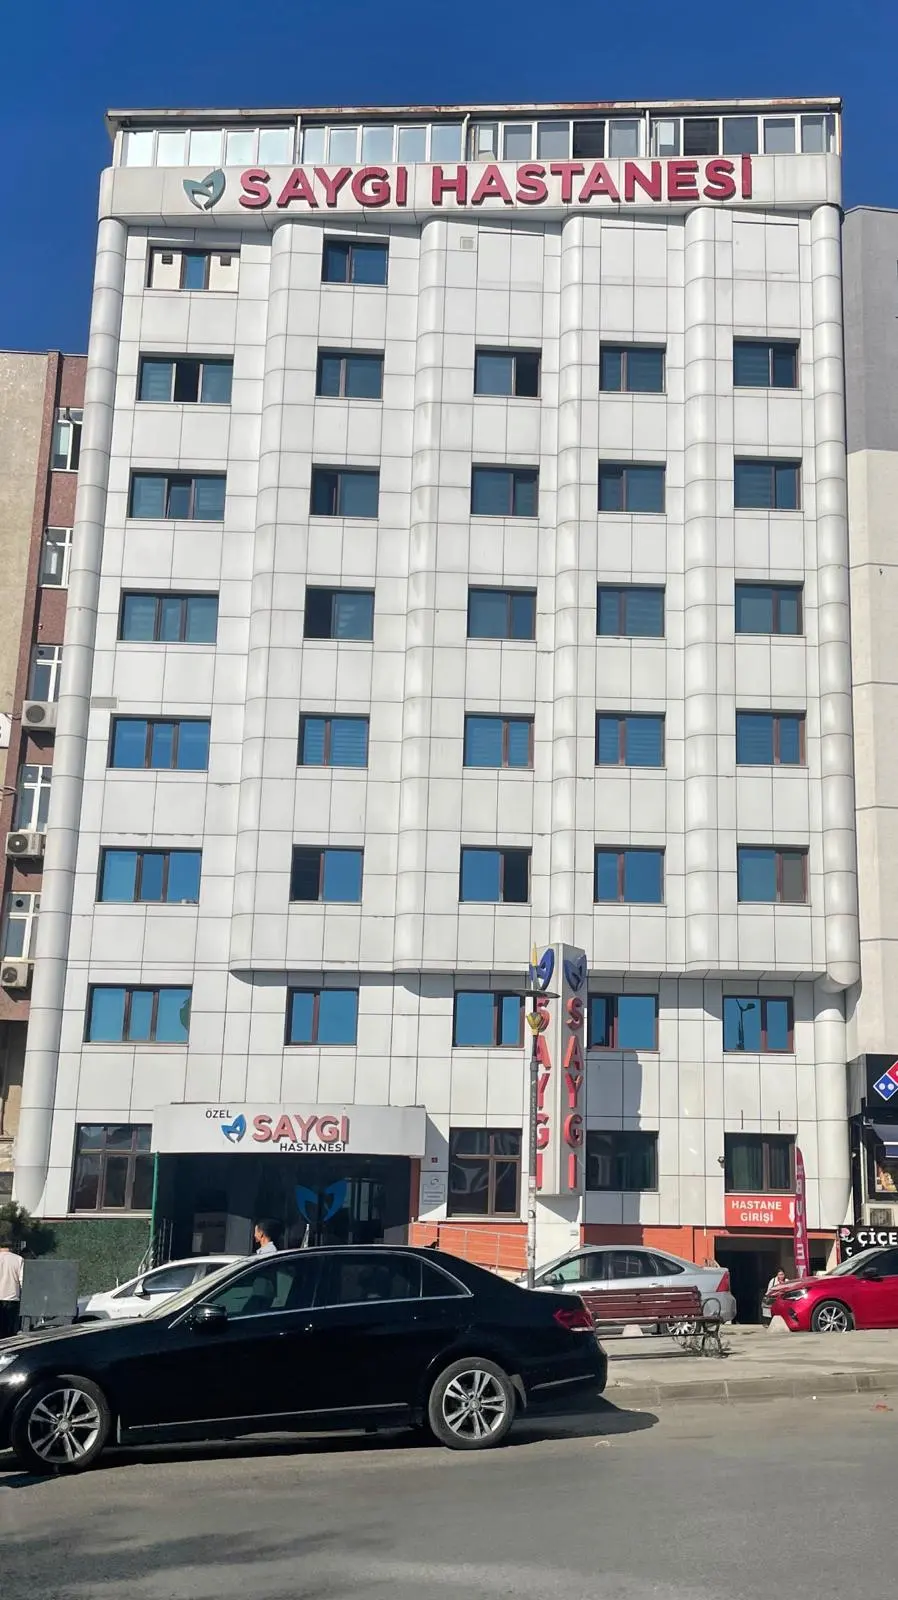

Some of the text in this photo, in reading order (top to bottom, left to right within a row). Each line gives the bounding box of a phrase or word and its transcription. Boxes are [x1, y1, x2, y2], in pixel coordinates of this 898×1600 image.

[239, 154, 753, 207] SAYGI HASTANESİ
[563, 997, 583, 1189] SAYGI
[205, 1108, 232, 1119] ÖZEL
[252, 1114, 349, 1144] SAYGI
[279, 1141, 346, 1153] HASTANESİ
[731, 1200, 782, 1210] HASTANE
[740, 1210, 774, 1224] GİRİŞİ
